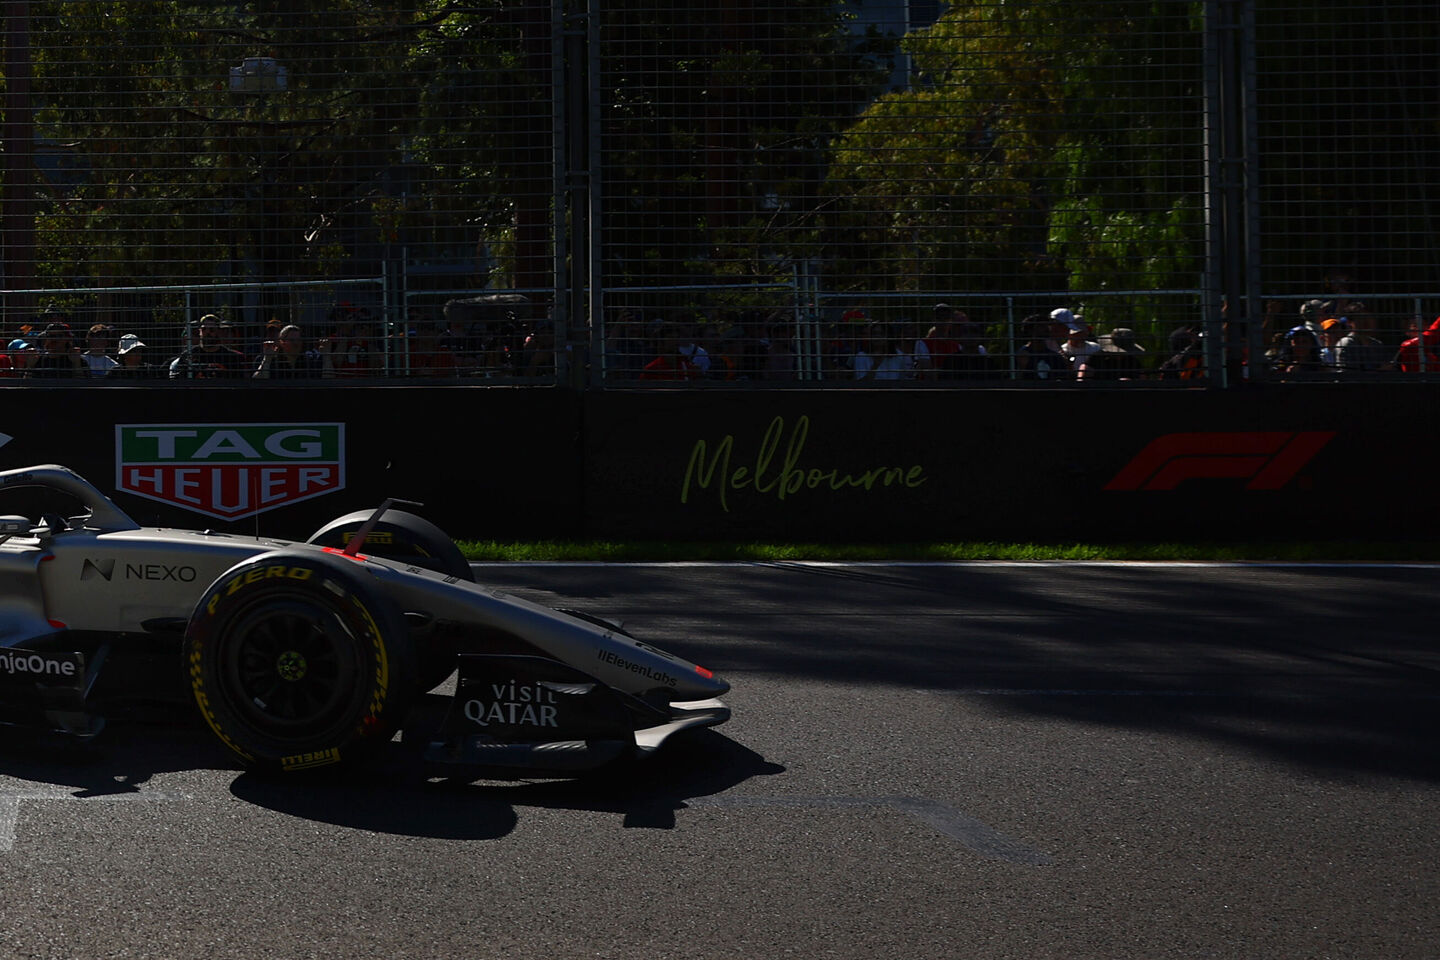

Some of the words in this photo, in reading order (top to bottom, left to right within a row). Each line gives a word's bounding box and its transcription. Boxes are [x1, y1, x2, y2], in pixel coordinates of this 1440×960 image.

[135, 429, 323, 459] TAG
[680, 414, 928, 513] Melbourne
[130, 467, 332, 514] HEUER
[126, 564, 197, 582] NEXO
[225, 565, 312, 596] ZERO
[464, 699, 559, 727] QATAR
[280, 747, 343, 773] PIRELLI
